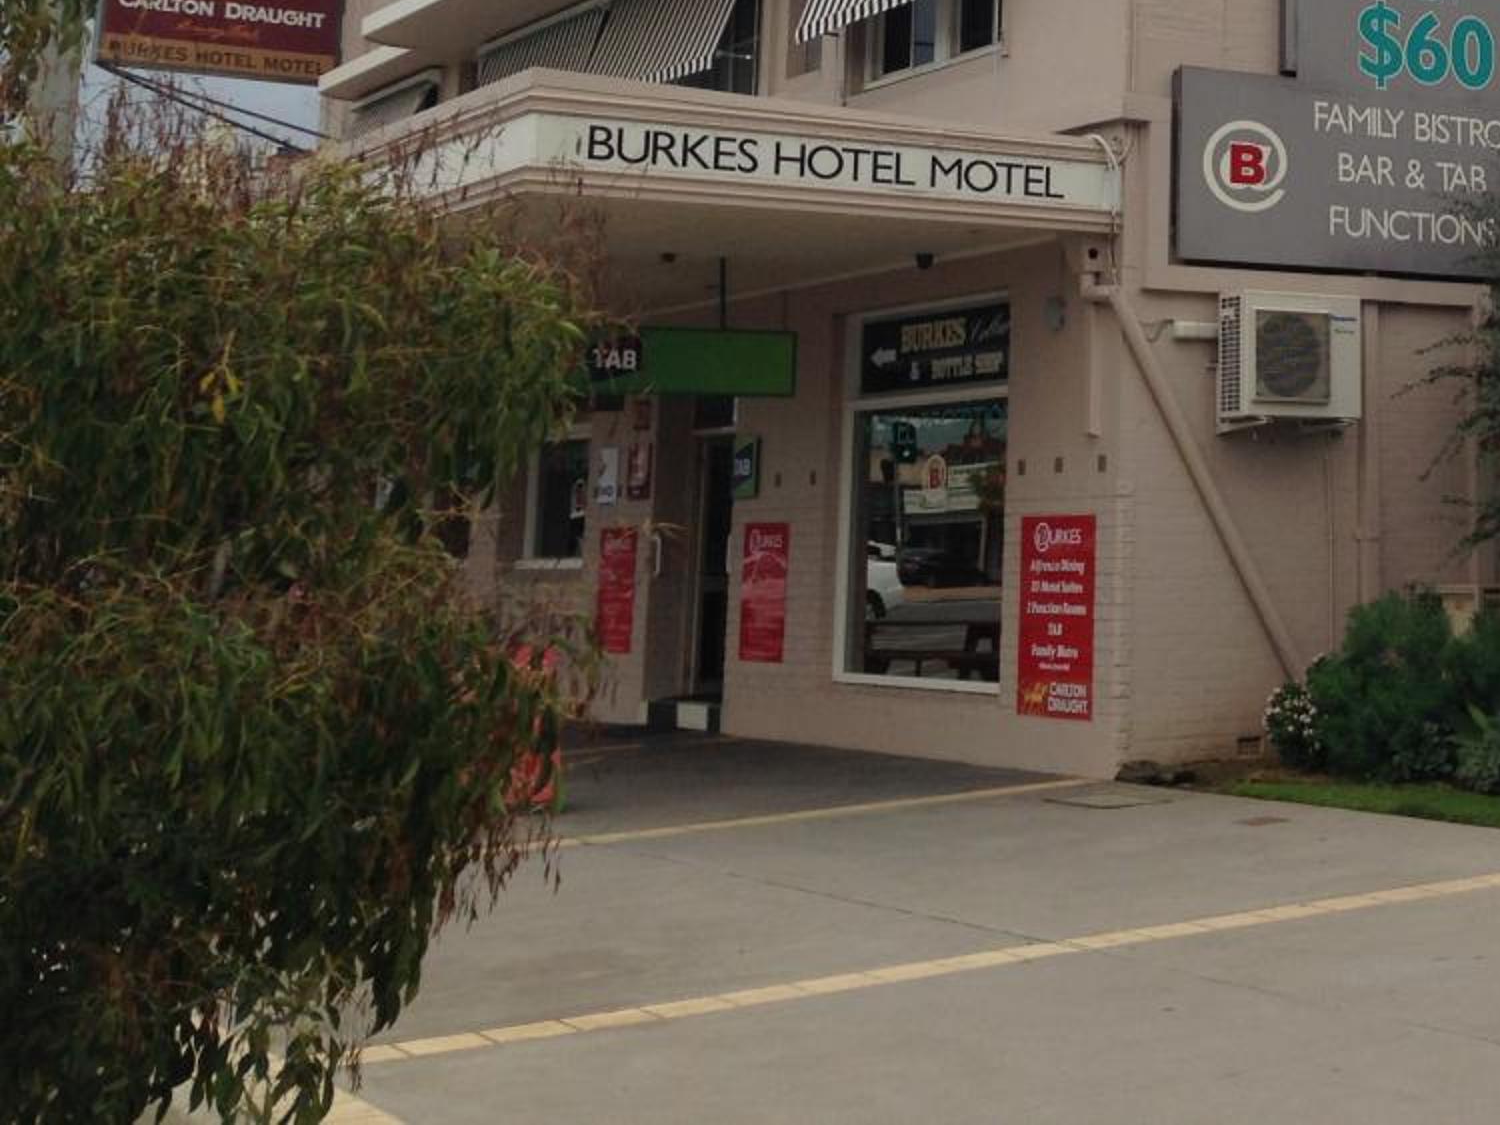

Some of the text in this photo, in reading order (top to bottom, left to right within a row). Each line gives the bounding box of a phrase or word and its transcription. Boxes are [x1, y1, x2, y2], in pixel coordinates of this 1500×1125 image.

[225, 2, 326, 29] DRAUGHT
[195, 49, 257, 69] HOTEL
[1313, 101, 1406, 141] FAMILY
[586, 124, 1066, 200] BURKES HOTEL MOTEL
[1337, 152, 1488, 194] BAR & TAB
[901, 317, 967, 354] BURKES
[1047, 696, 1089, 714] DRAUGHT
[1049, 682, 1087, 698] CARLTON
